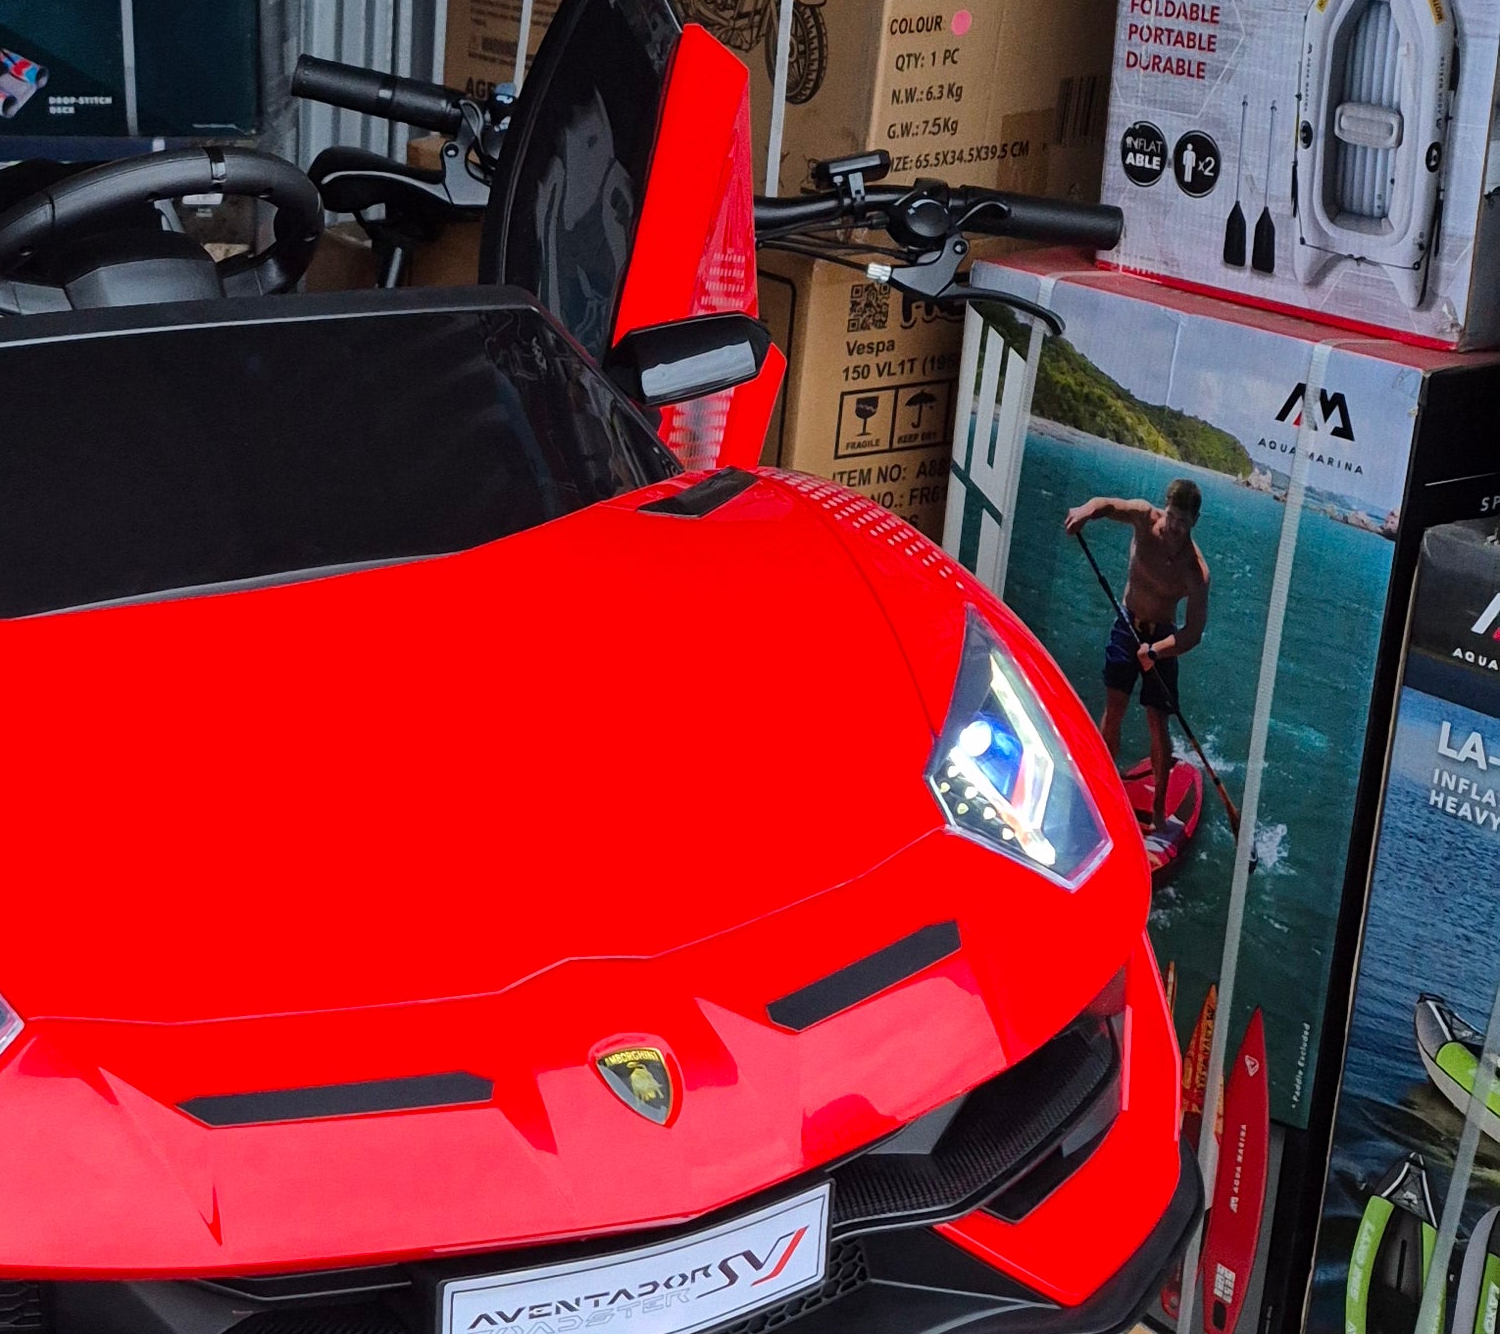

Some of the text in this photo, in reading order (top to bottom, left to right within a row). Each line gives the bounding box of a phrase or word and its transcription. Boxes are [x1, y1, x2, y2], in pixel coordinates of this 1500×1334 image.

[1127, 22, 1218, 53] PORTABLE
[895, 48, 960, 72] QTY: 1 PC
[1126, 50, 1207, 80] DURABLE
[49, 96, 113, 105] DROP-STITCH
[947, 82, 963, 103] Kg
[890, 154, 913, 173] IZE:
[1010, 140, 1030, 158] CM
[1125, 151, 1162, 171] ABLE
[1197, 156, 1216, 177] x2
[846, 339, 896, 357] Vespa
[842, 364, 871, 382] 150
[875, 358, 918, 378] VL1T
[846, 438, 881, 451] FRAGILE
[897, 433, 918, 445] KEEP
[1258, 437, 1296, 455] AQUA
[832, 464, 907, 488] ITEM NO:
[1298, 1022, 1311, 1068] Excluded
[467, 1263, 714, 1330] AVENTADOR
